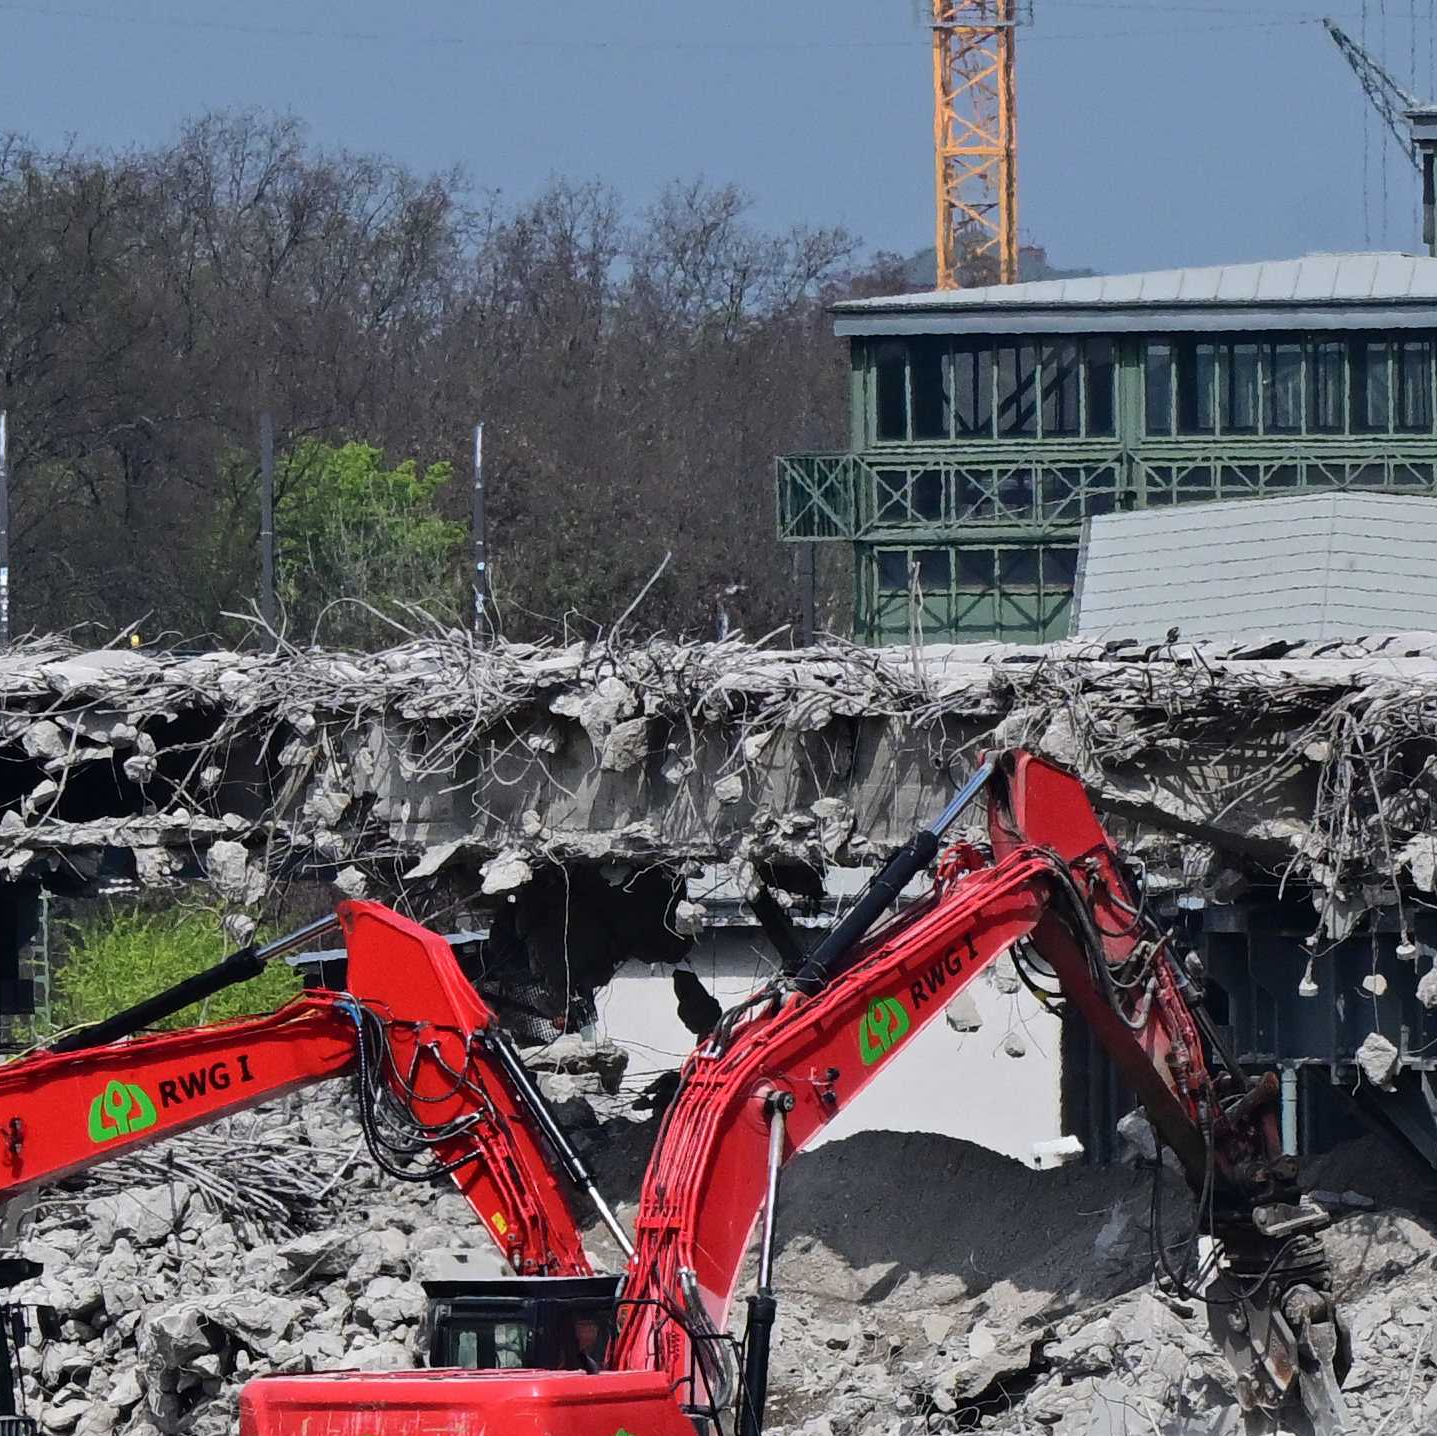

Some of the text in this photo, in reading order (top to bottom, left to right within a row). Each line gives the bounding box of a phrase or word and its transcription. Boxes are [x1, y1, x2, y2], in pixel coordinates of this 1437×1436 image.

[909, 947, 962, 1010] RWG
[158, 1054, 254, 1108] RWG I
